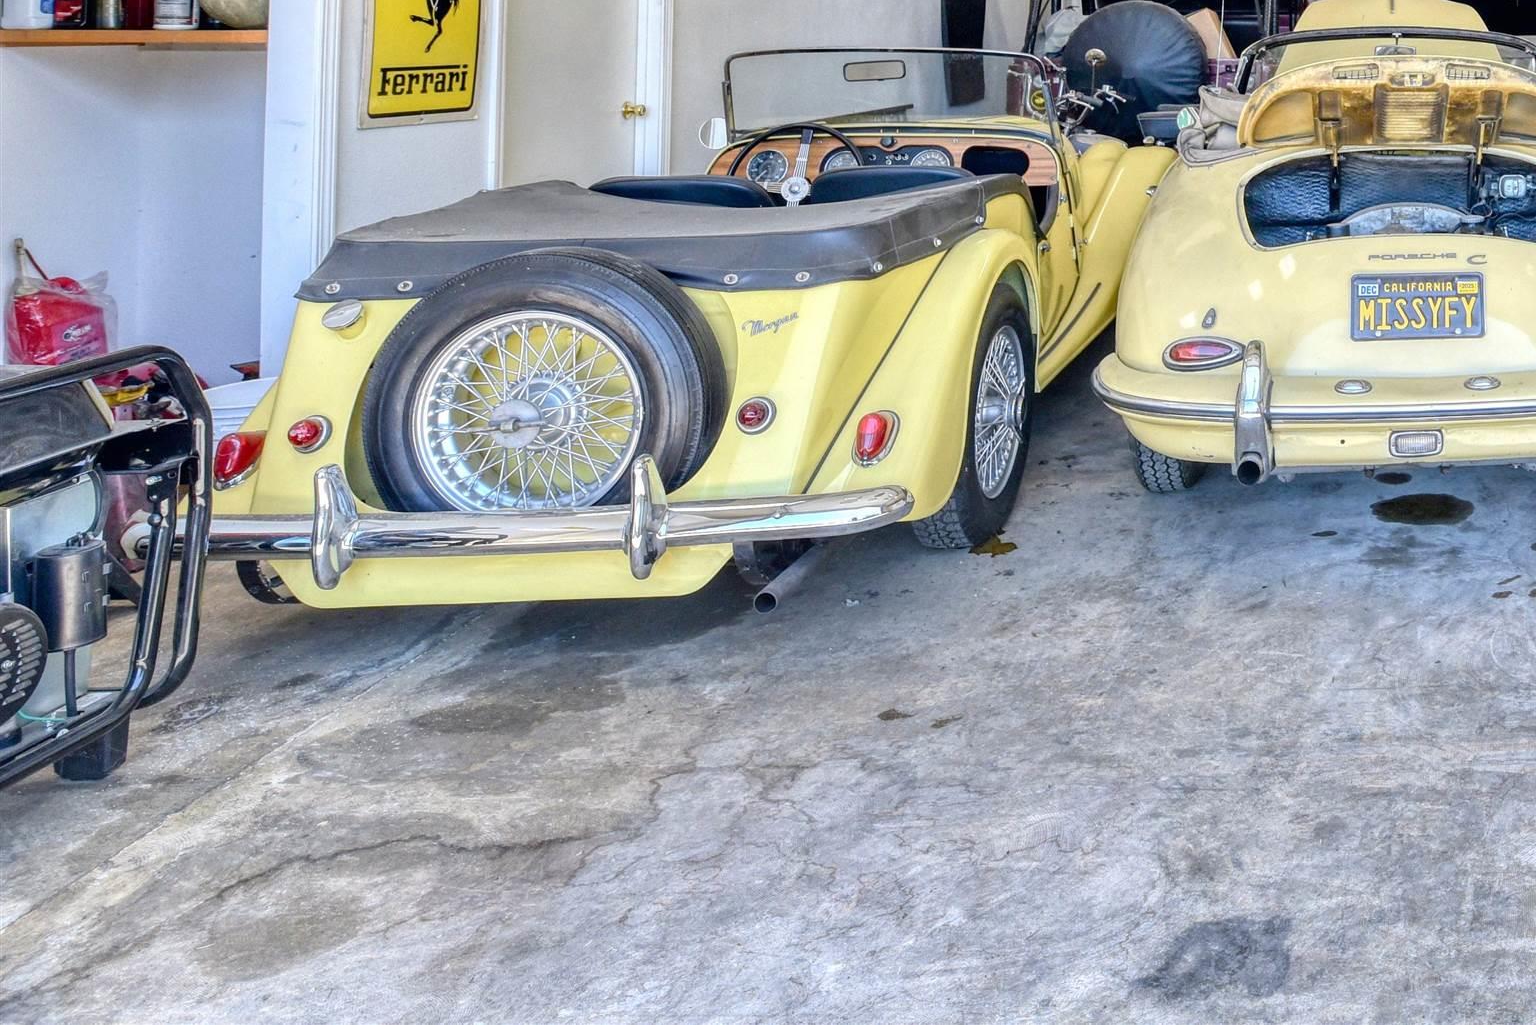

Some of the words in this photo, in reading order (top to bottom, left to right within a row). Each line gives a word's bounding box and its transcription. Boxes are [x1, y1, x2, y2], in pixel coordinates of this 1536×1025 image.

[377, 64, 468, 96] Ferrari
[1368, 252, 1457, 261] PORSCHE
[1466, 254, 1488, 265] C
[1360, 286, 1377, 295] DEC
[1383, 281, 1453, 293] CALIFORNIA
[1359, 296, 1477, 331] MISSYFY
